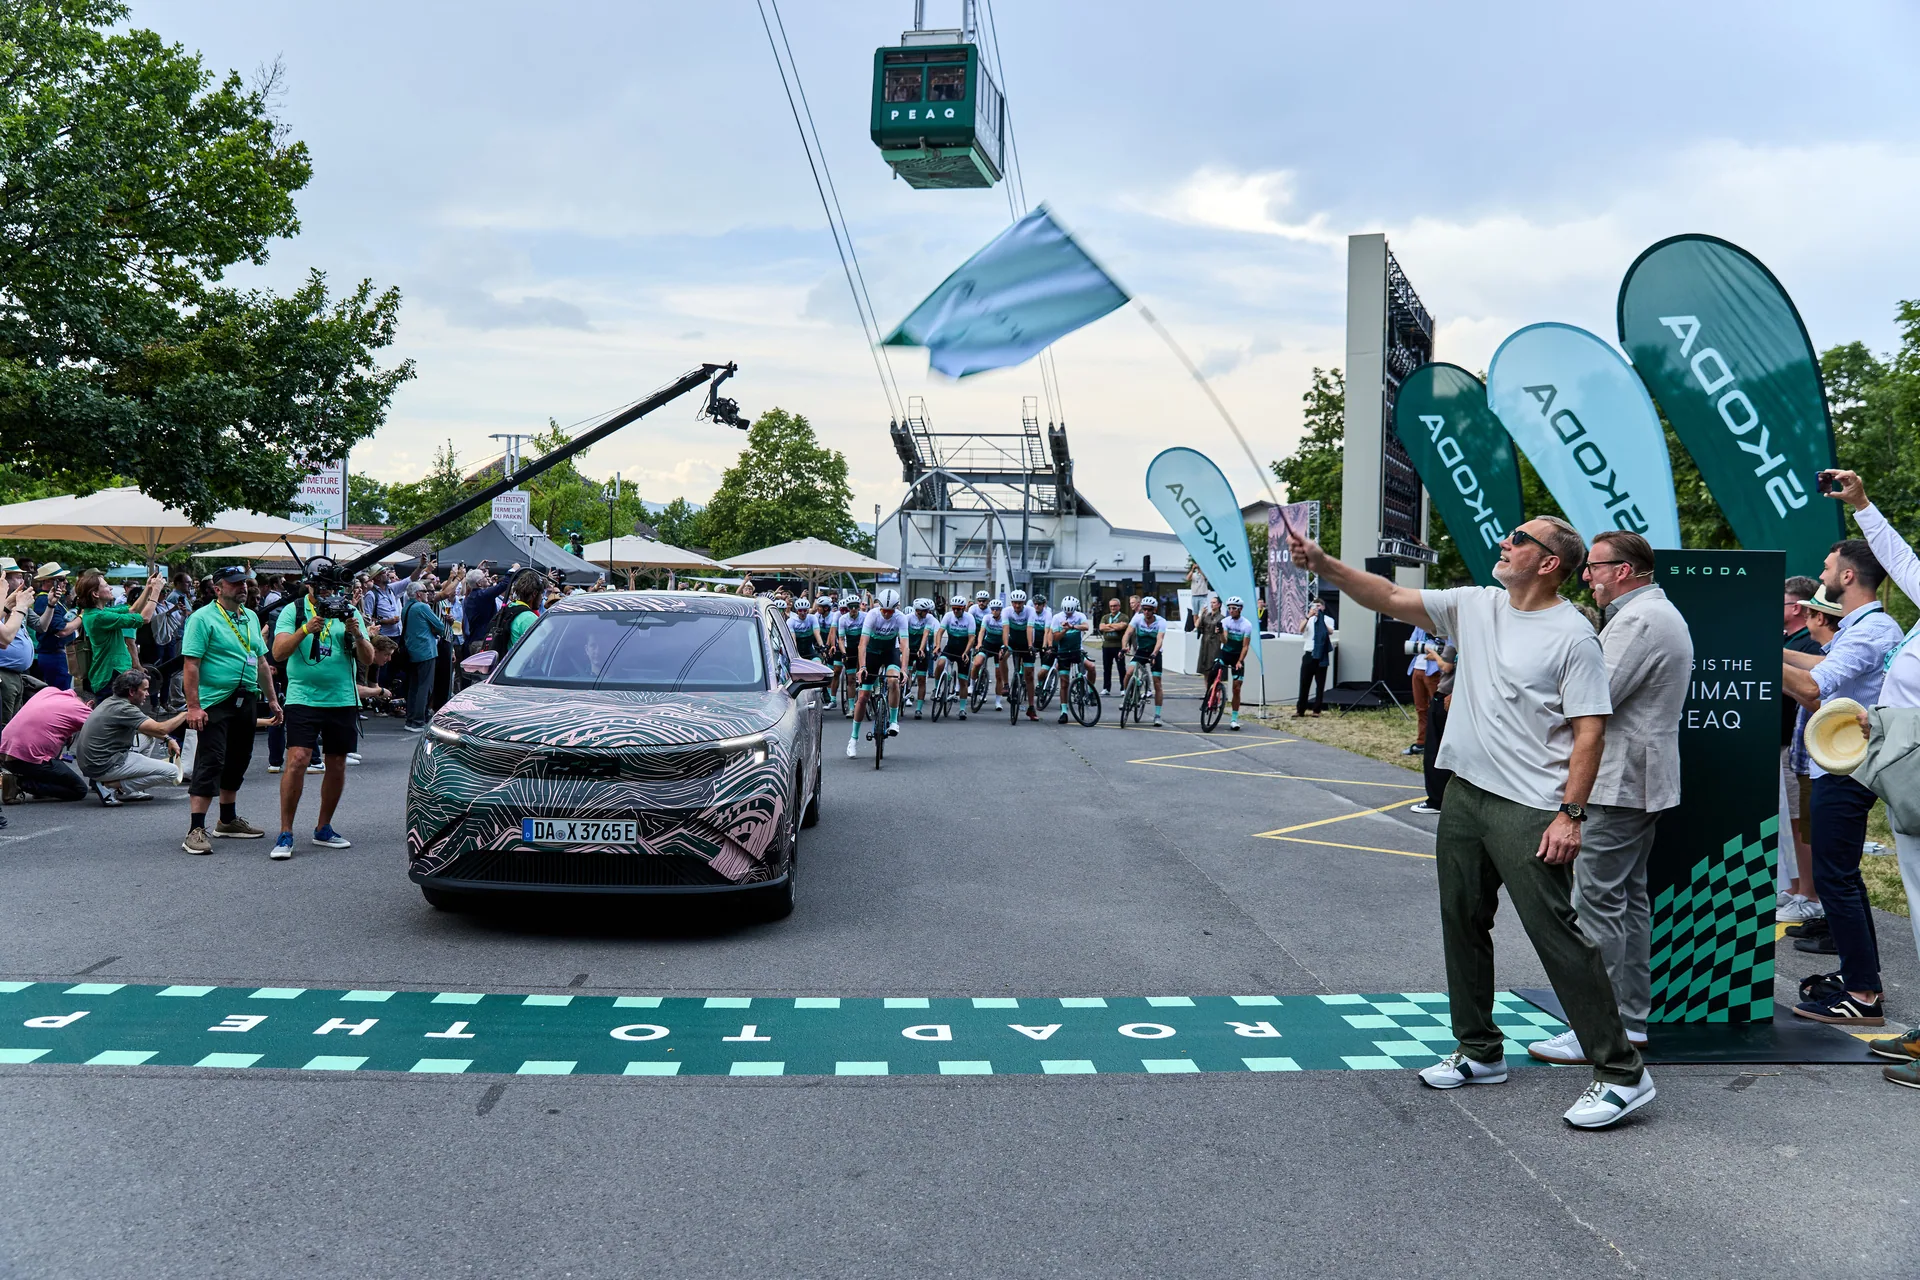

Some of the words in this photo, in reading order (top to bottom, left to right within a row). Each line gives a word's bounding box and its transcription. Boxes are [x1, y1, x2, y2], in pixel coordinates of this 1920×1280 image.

[891, 108, 955, 120] PEAQ
[302, 476, 339, 486] RMETURE
[307, 486, 340, 495] PARKING
[1270, 550, 1293, 563] SKO
[1702, 659, 1717, 671] IS
[1722, 659, 1753, 671] THE
[1691, 681, 1773, 701] IMATE
[1678, 710, 1742, 730] EAQ
[534, 822, 556, 840] DA
[567, 822, 577, 840] X
[207, 1014, 475, 1039] THE
[609, 1023, 772, 1042] TO
[902, 1021, 1283, 1041] ROAD
